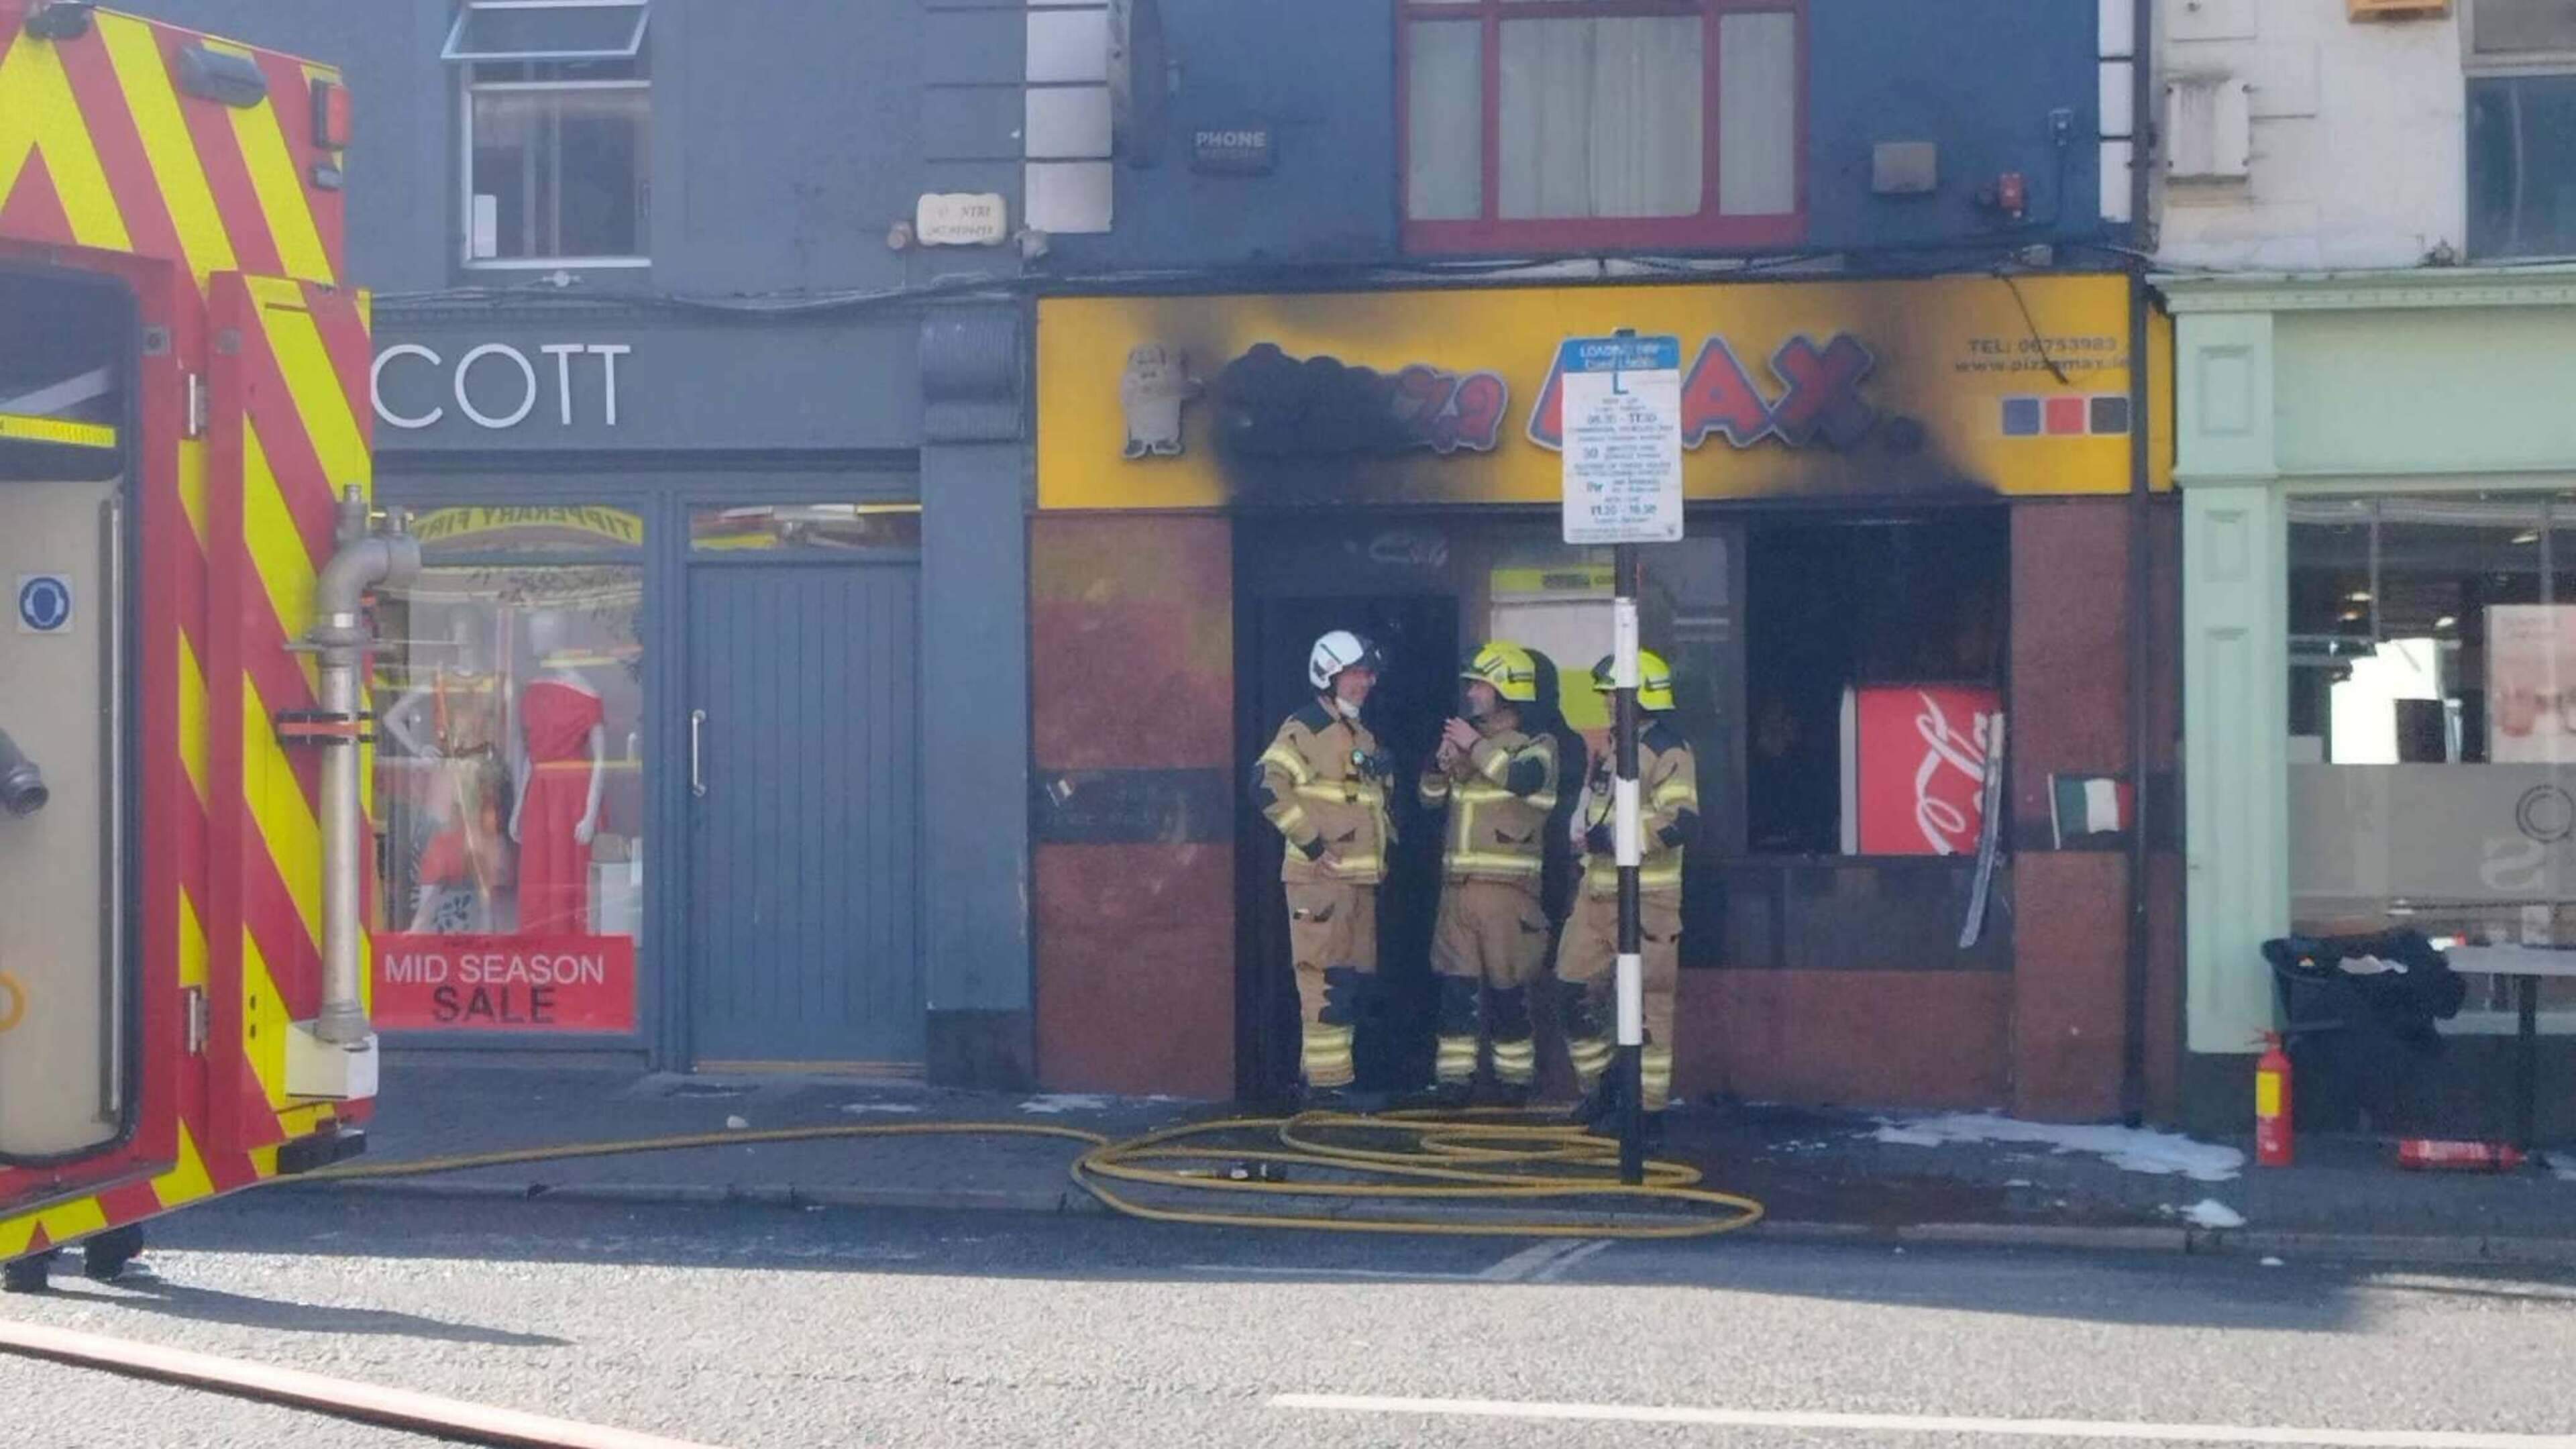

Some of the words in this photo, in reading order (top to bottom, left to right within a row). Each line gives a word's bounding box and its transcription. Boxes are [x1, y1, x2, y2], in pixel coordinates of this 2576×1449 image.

[1196, 131, 1266, 147] PHONE
[384, 954, 448, 983] MID
[459, 953, 604, 984] SEASON
[433, 985, 555, 1024] SALE
